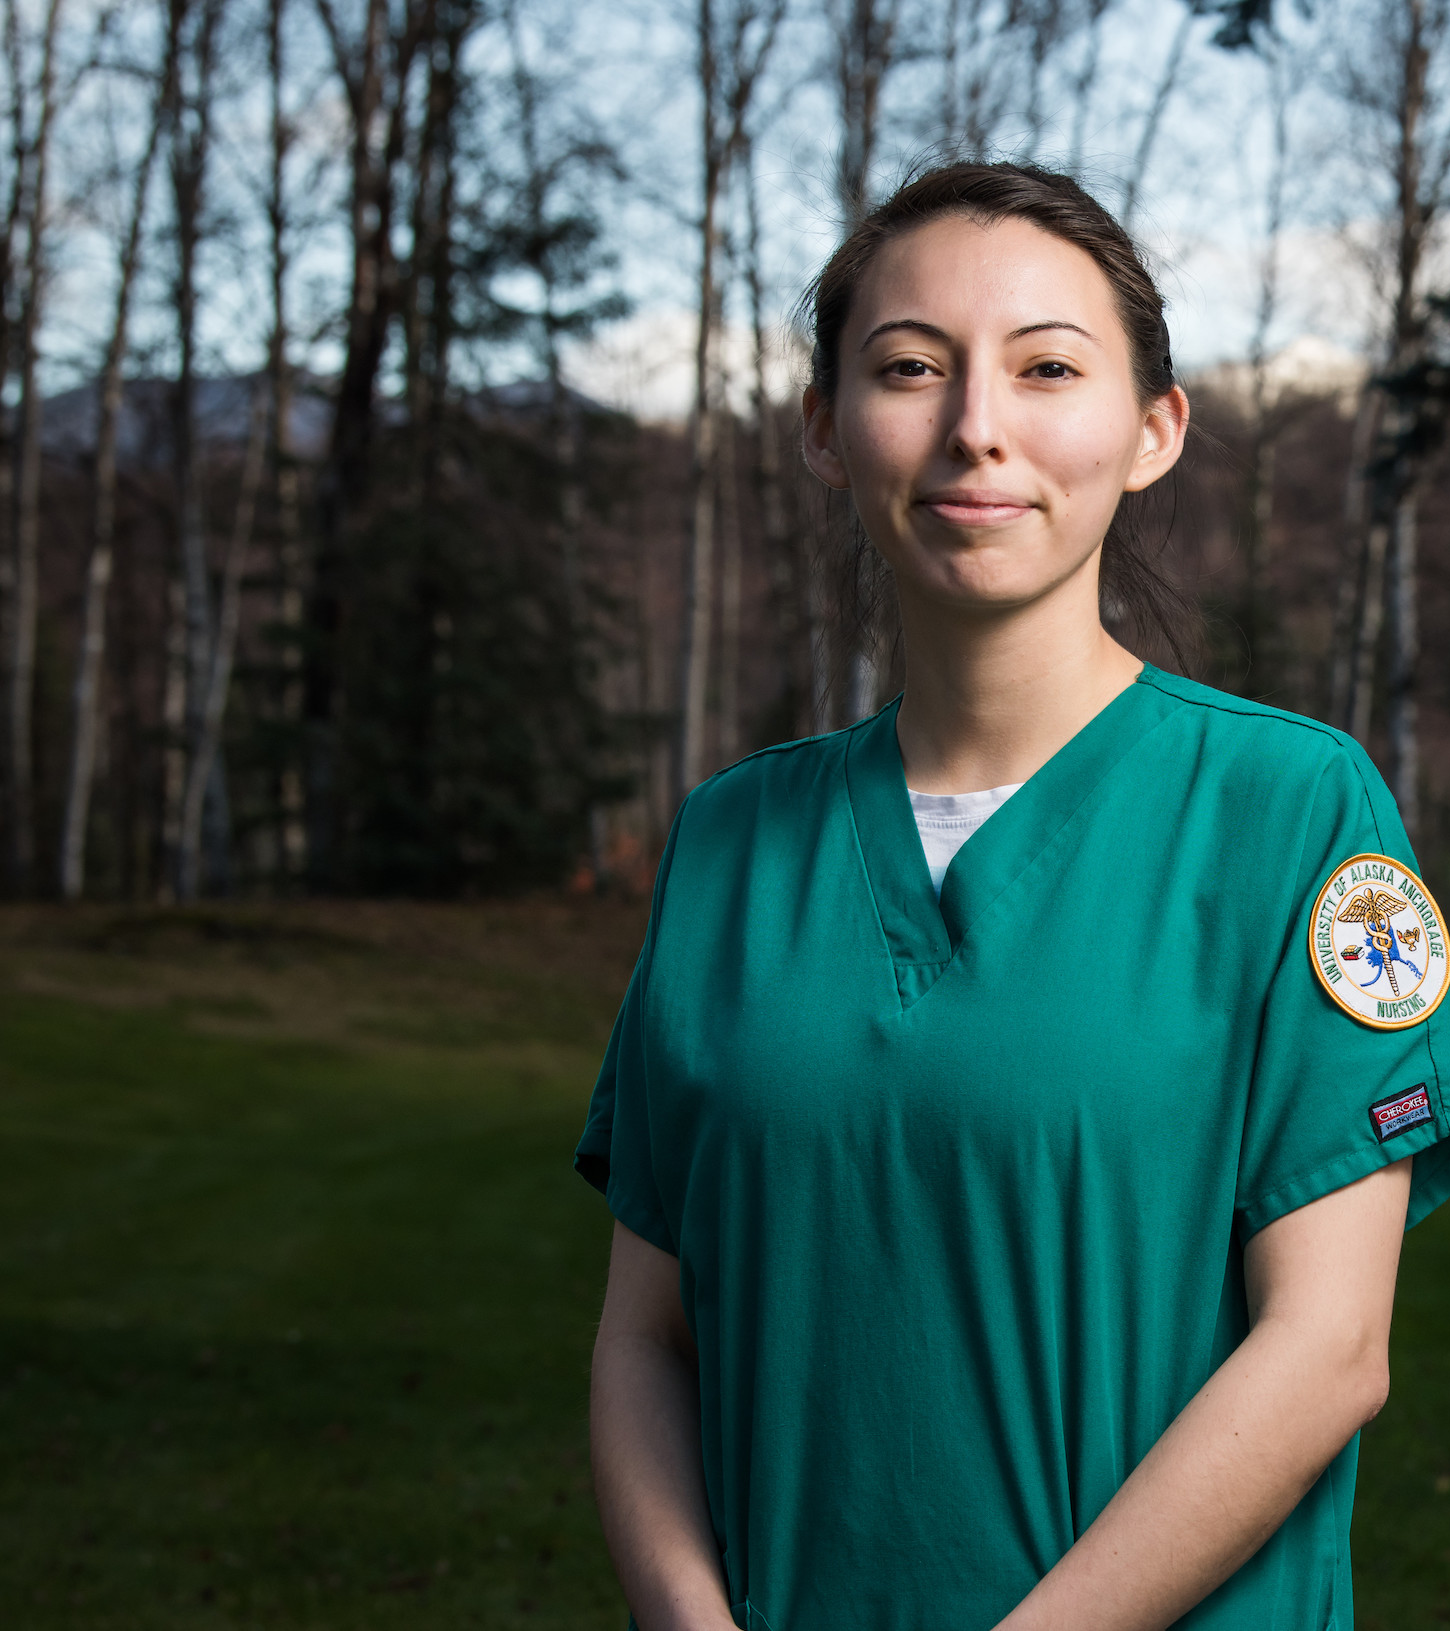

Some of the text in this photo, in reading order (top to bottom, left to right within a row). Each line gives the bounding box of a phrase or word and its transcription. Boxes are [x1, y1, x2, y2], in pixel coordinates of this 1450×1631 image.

[1317, 863, 1444, 984] UNIVERSITY OF ALASKA ANCHORAGE
[1377, 993, 1427, 1019] NURSING
[1378, 1095, 1423, 1121] CHEROKEE
[1385, 1108, 1425, 1130] WORKWEAR
